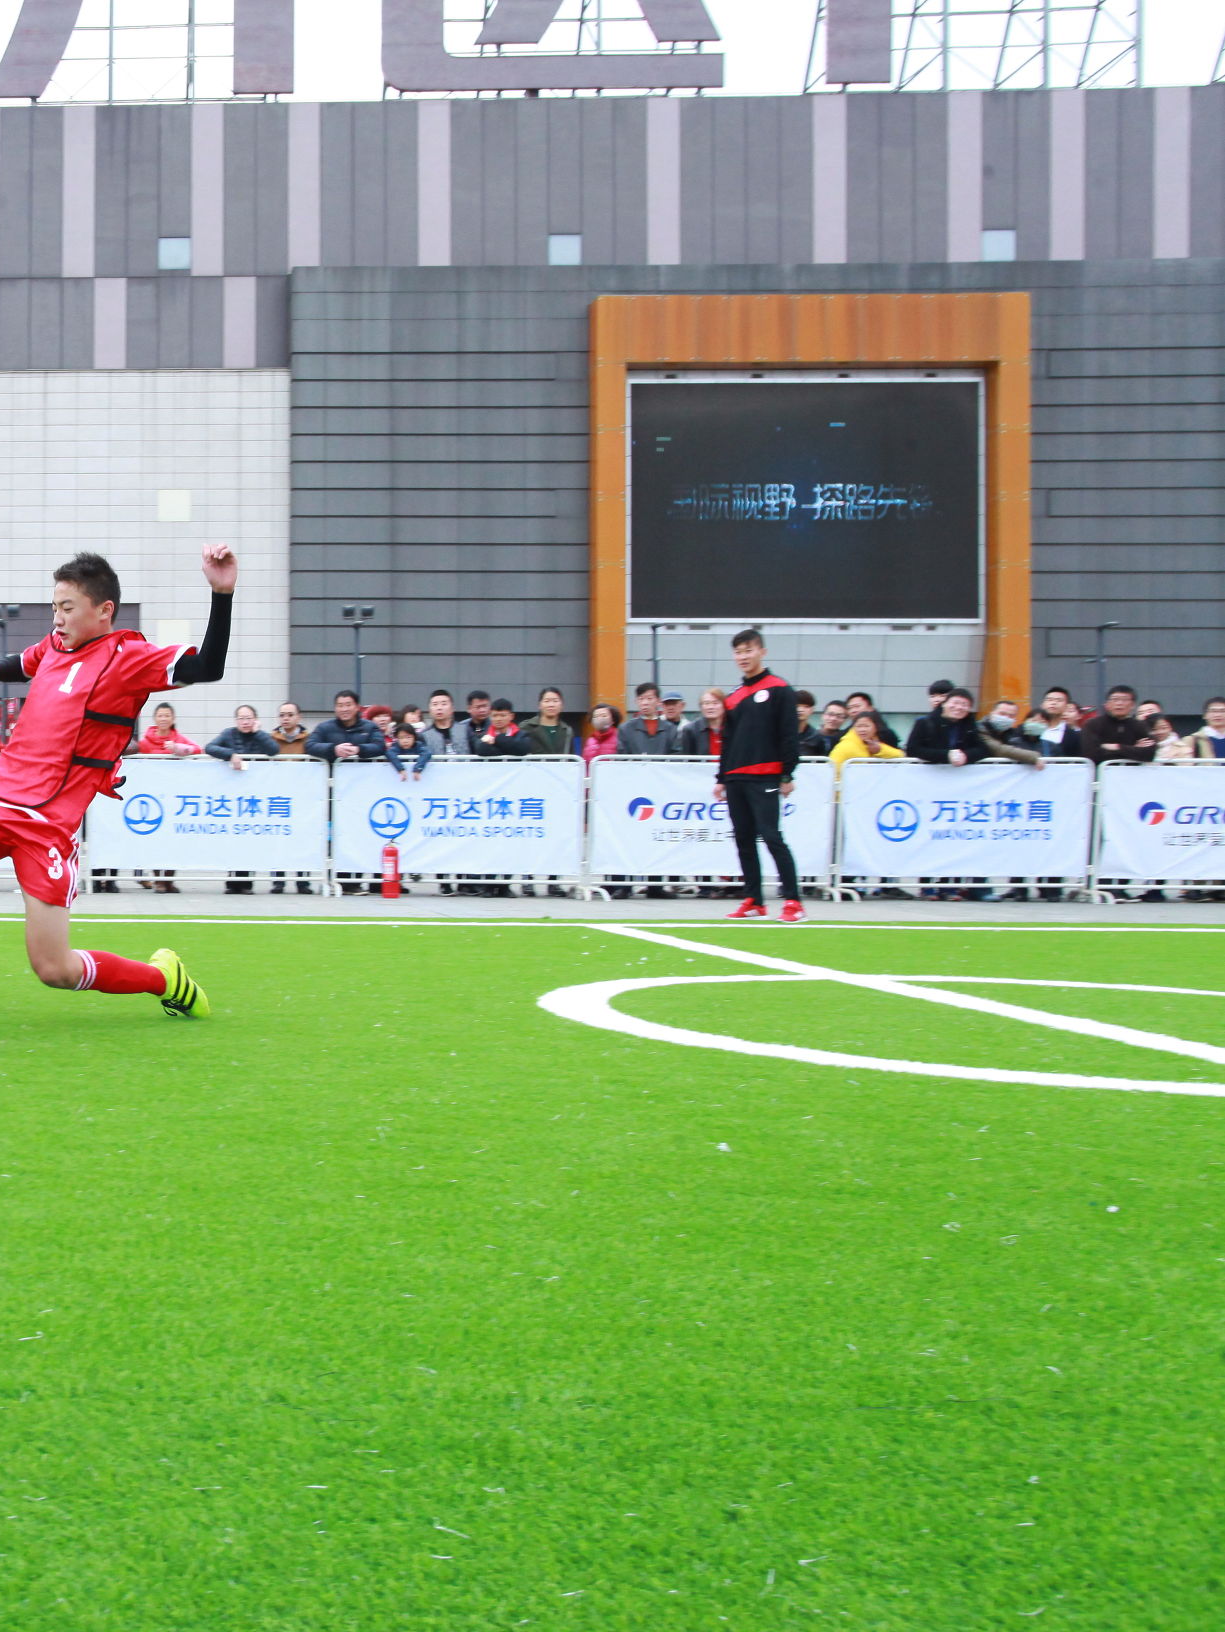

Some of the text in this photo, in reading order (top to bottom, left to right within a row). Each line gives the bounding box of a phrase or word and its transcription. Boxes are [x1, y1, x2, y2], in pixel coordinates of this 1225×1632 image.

[58, 661, 84, 694] 1
[175, 794, 292, 818] 万达体育
[422, 797, 545, 820] 万达体育
[662, 802, 728, 820] GRE
[930, 800, 1054, 823] 万达体育
[175, 823, 292, 836] WANDA SPORTS
[422, 826, 545, 838] WANDA SPORTS
[930, 829, 1053, 841] WANDA SPORTS
[47, 846, 64, 880] 3
